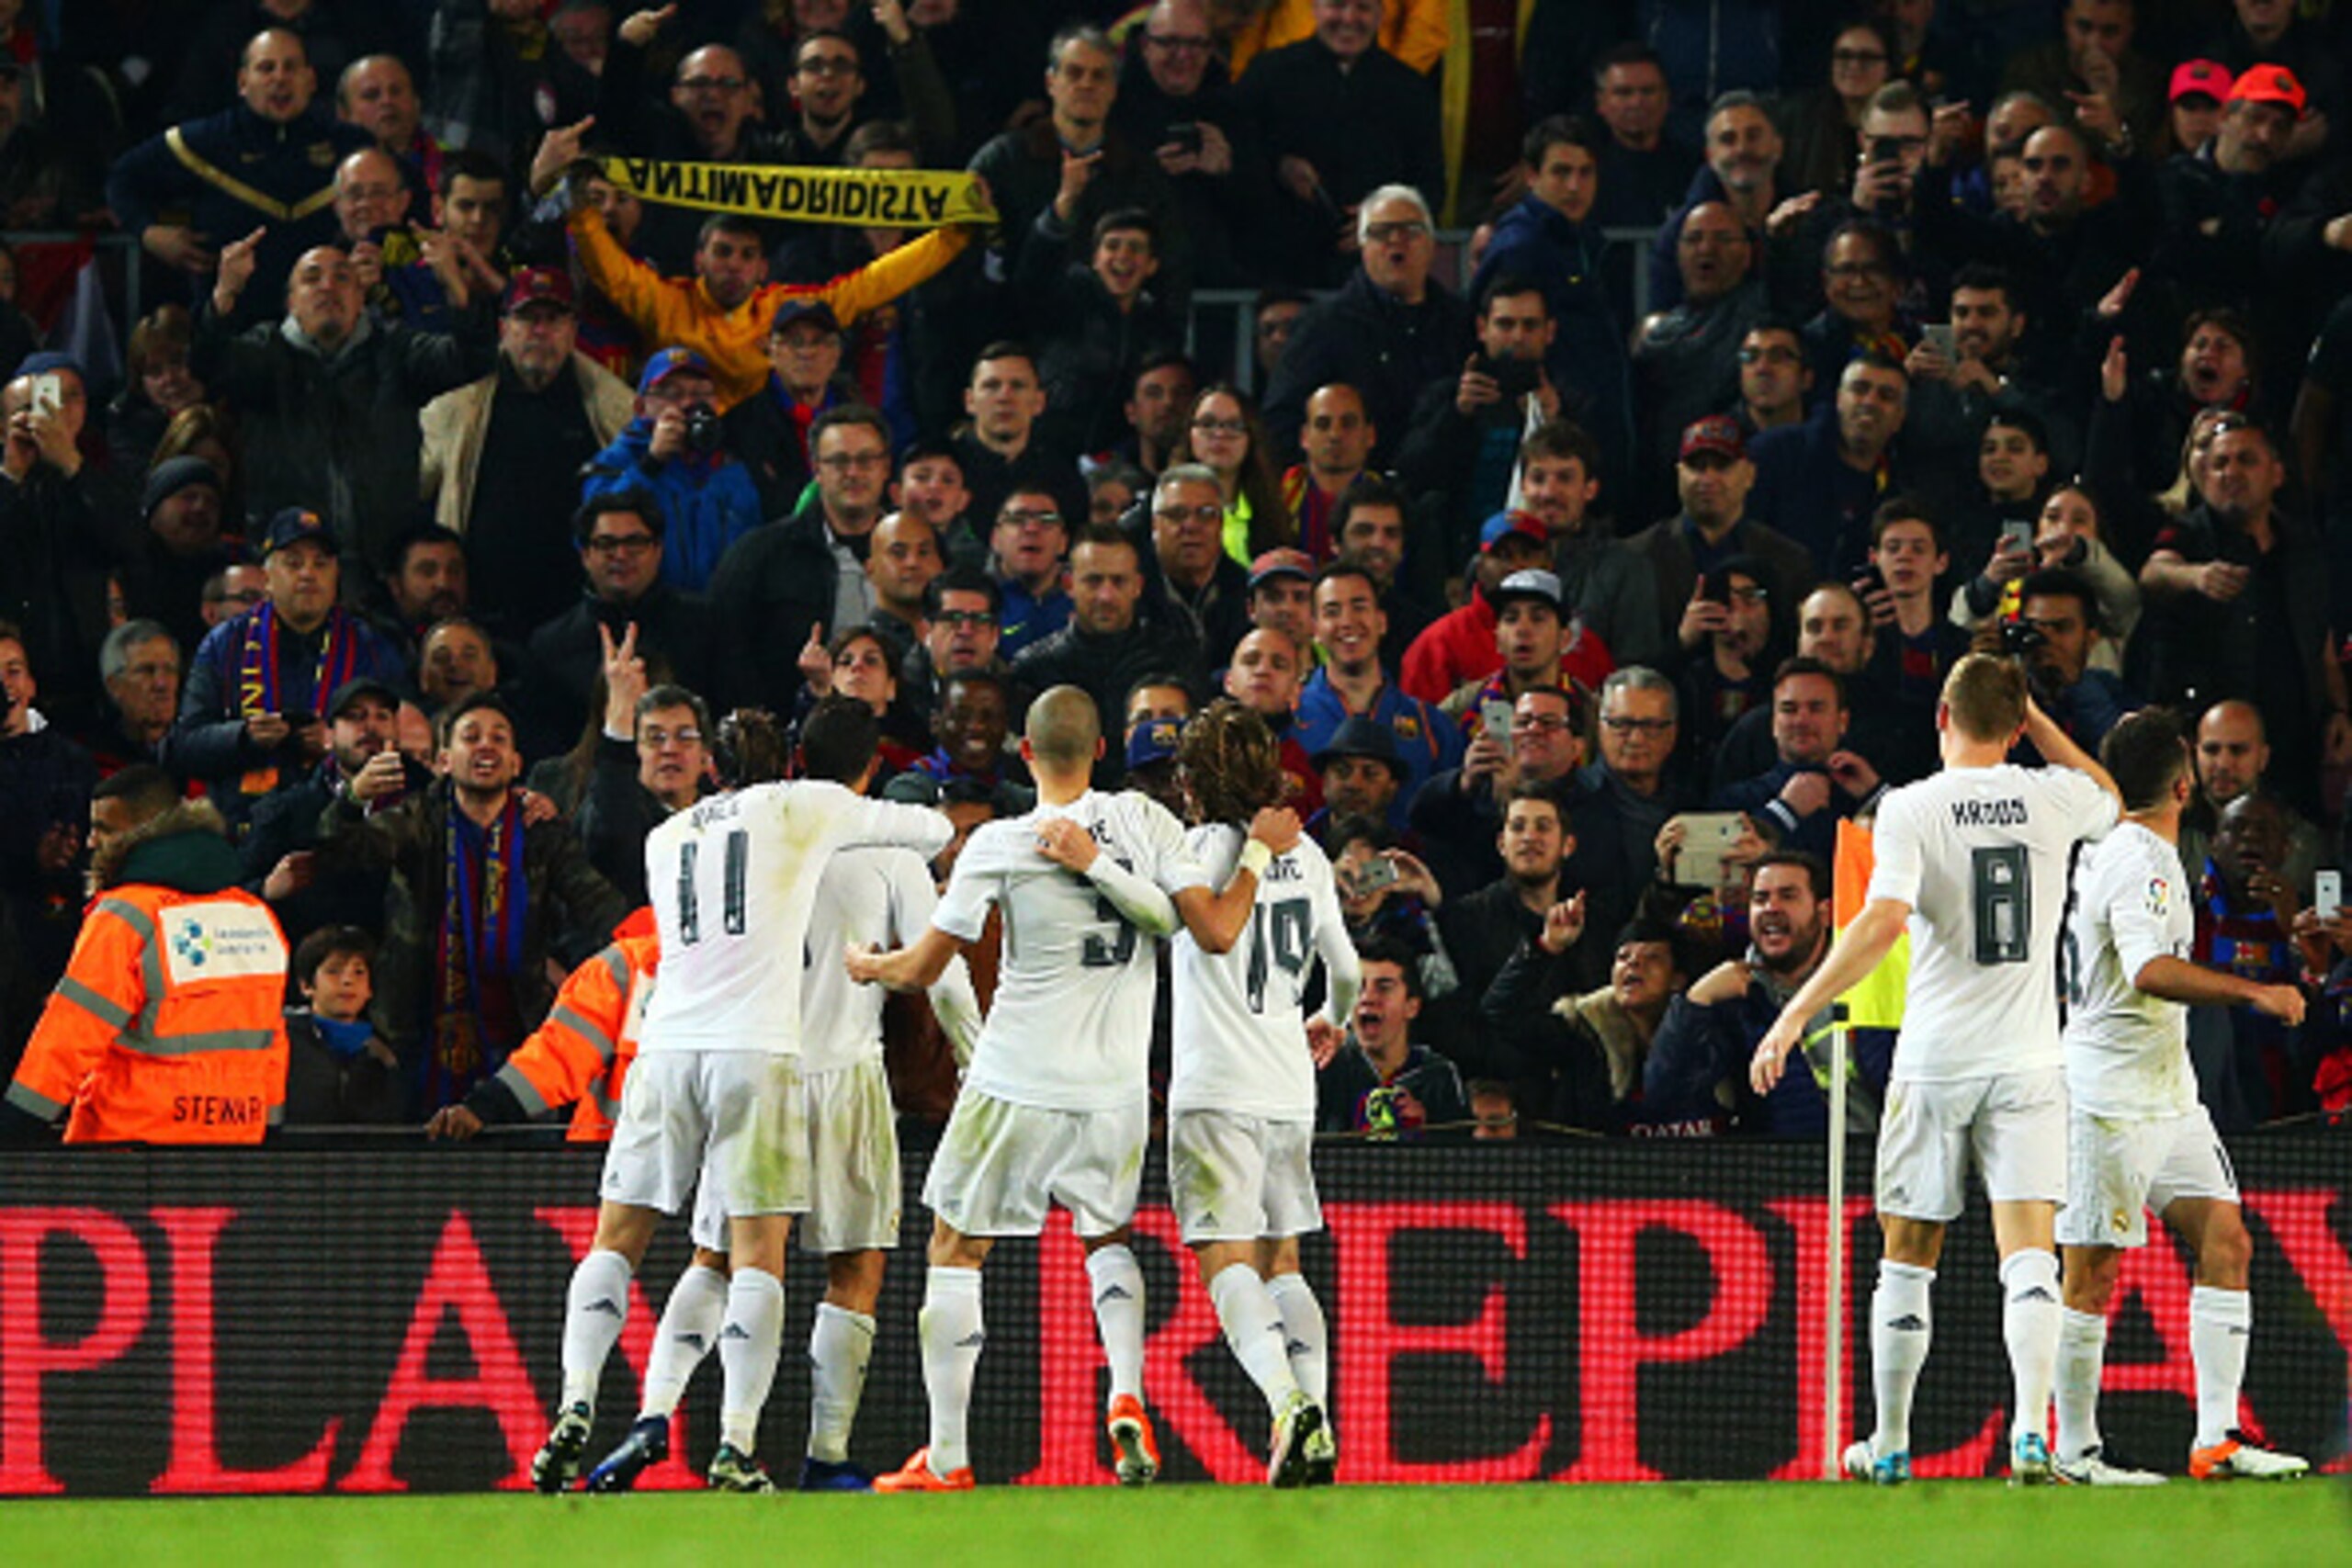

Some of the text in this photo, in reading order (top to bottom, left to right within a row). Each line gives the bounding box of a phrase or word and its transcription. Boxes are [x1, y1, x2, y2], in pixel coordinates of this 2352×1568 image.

[1951, 798, 2029, 826] KROOS
[678, 829, 748, 946] 11
[1973, 845, 2031, 964] 8
[1247, 898, 1314, 1014] 19
[173, 1096, 262, 1125] STEWAR
